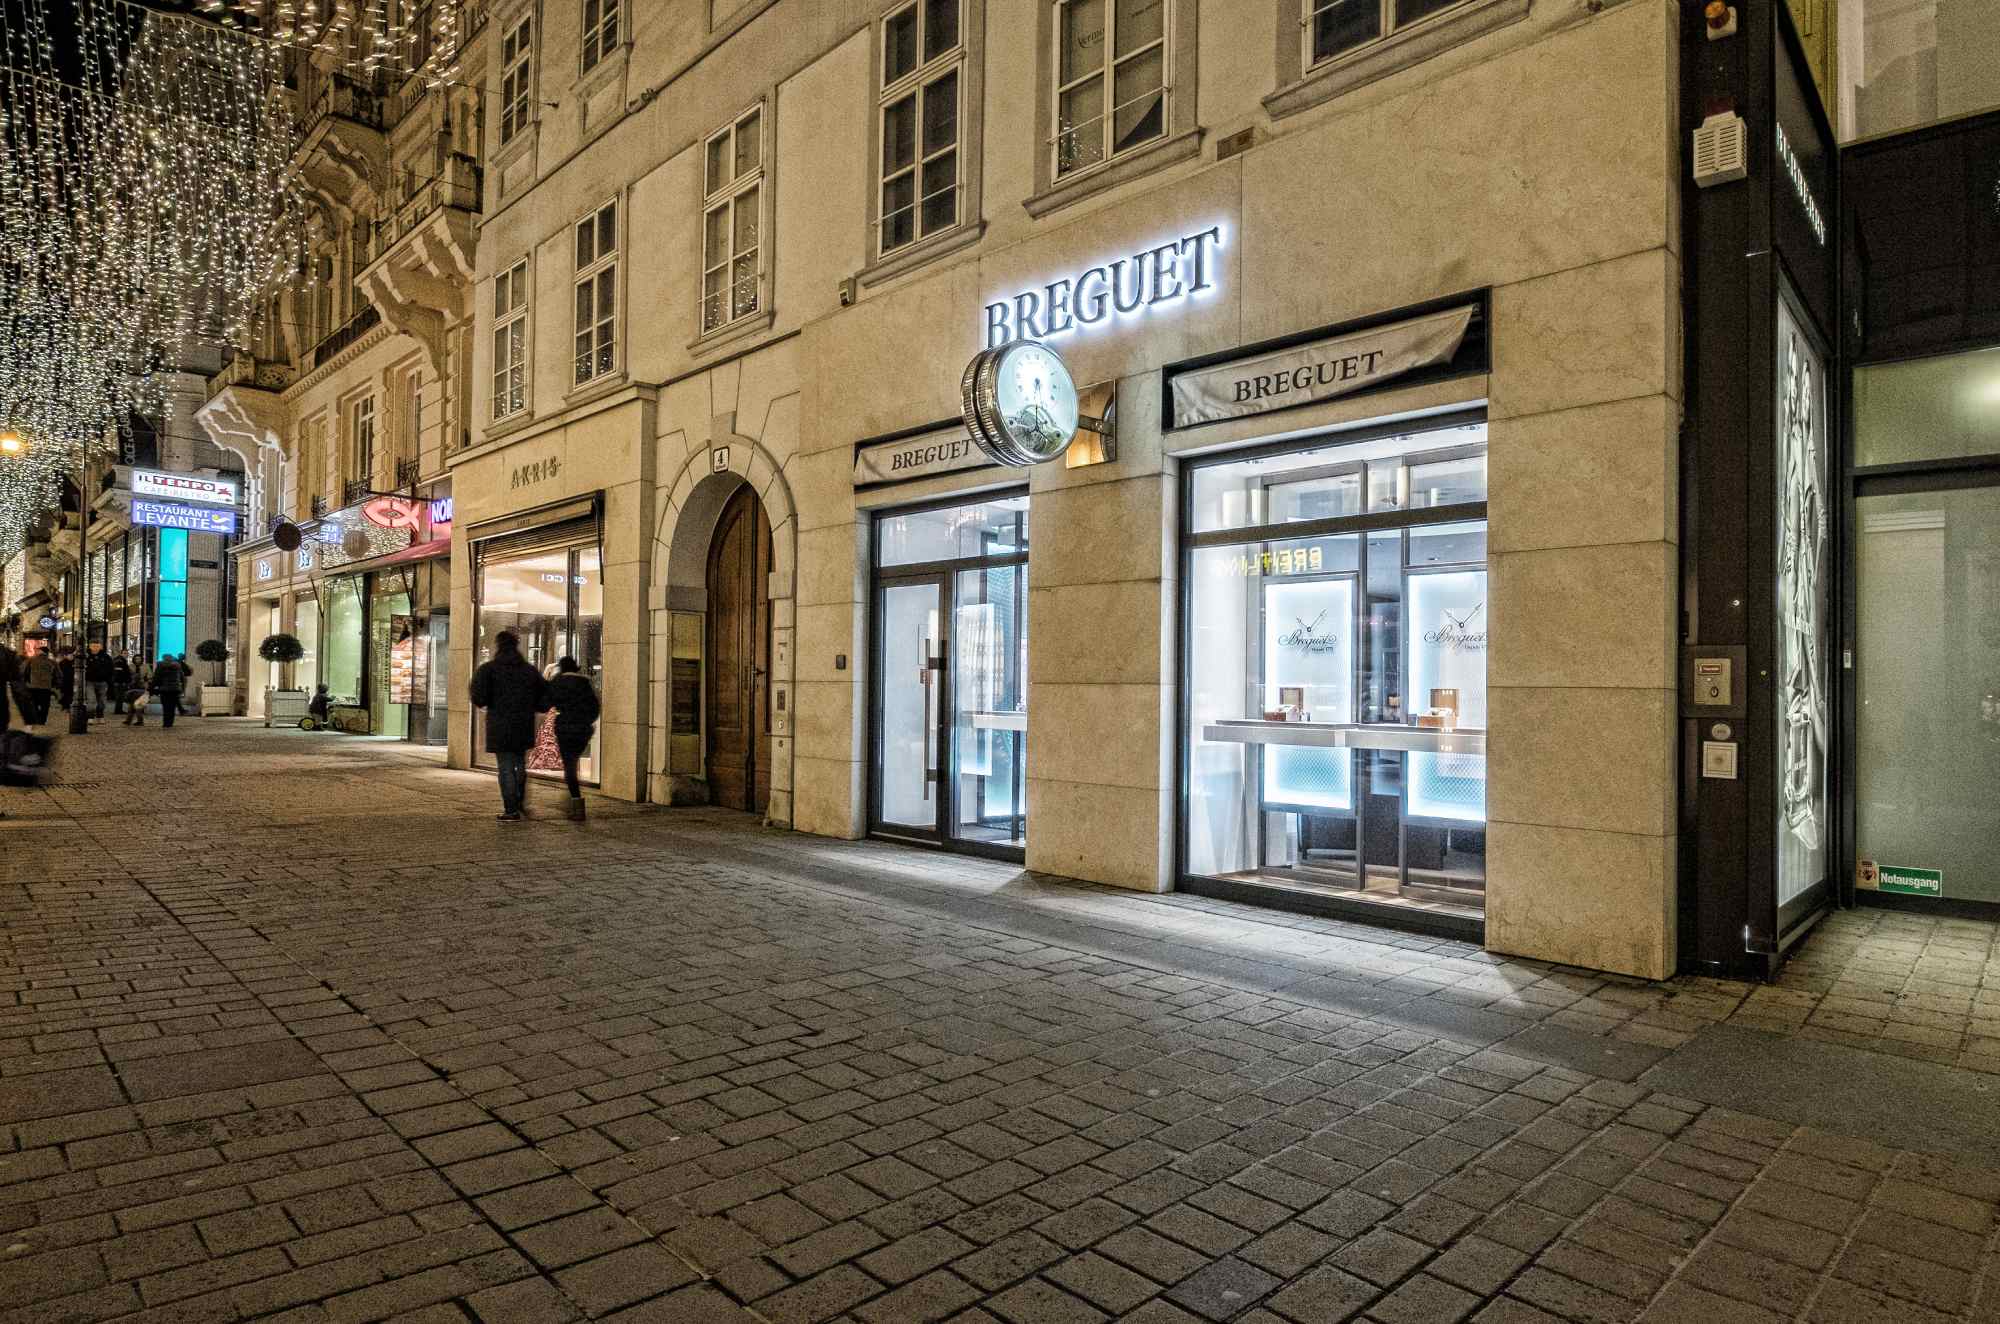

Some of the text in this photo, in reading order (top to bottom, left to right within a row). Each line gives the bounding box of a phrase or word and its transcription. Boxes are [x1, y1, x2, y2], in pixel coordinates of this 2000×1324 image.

[985, 226, 1220, 349] BREGUET
[1233, 350, 1384, 402] BREGUET
[891, 438, 975, 471] BREGUET
[138, 475, 215, 491] IL TEMPO
[136, 503, 209, 519] RESTAURANT
[136, 511, 211, 529] LEVANTE
[432, 498, 452, 522] NOR
[1881, 872, 1938, 890] Notausgang
